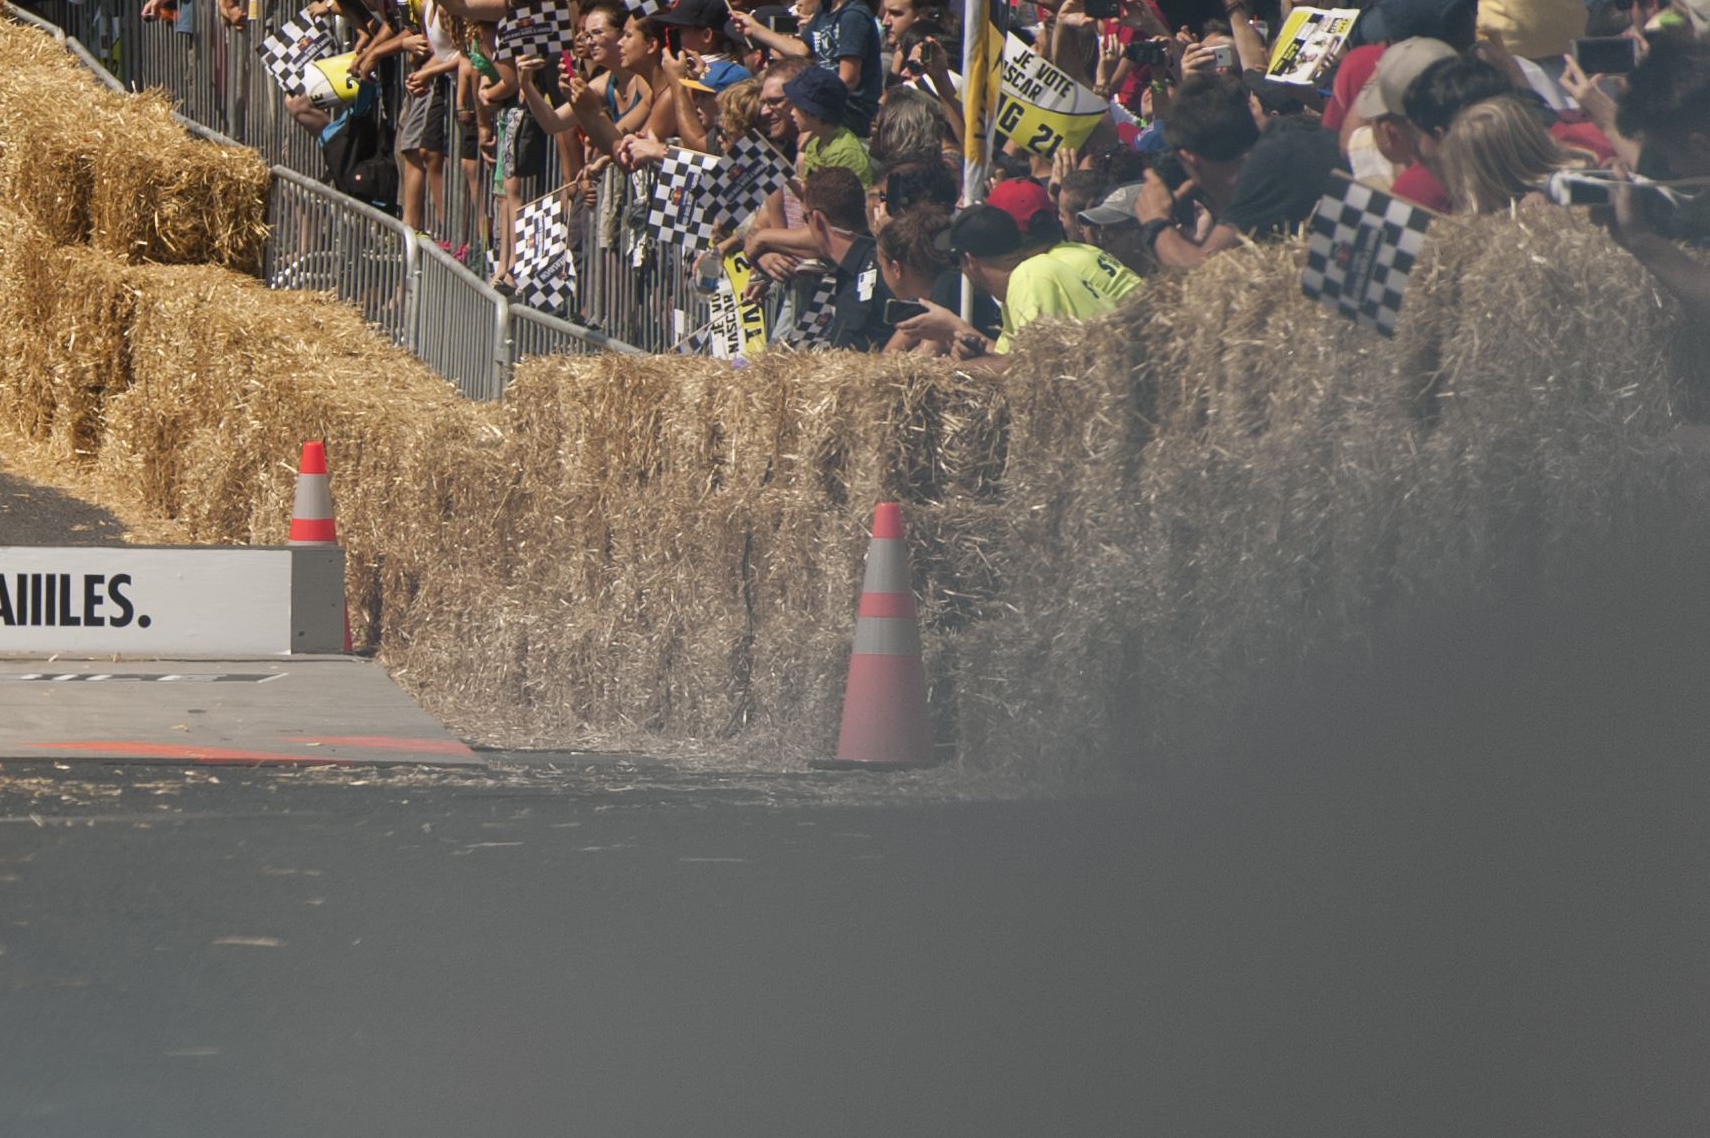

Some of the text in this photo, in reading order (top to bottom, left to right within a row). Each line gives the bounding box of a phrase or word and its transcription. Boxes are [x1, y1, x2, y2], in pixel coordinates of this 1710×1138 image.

[1002, 62, 1043, 101] SCAR
[1012, 49, 1075, 98] JE VOTE
[1027, 123, 1064, 159] 21
